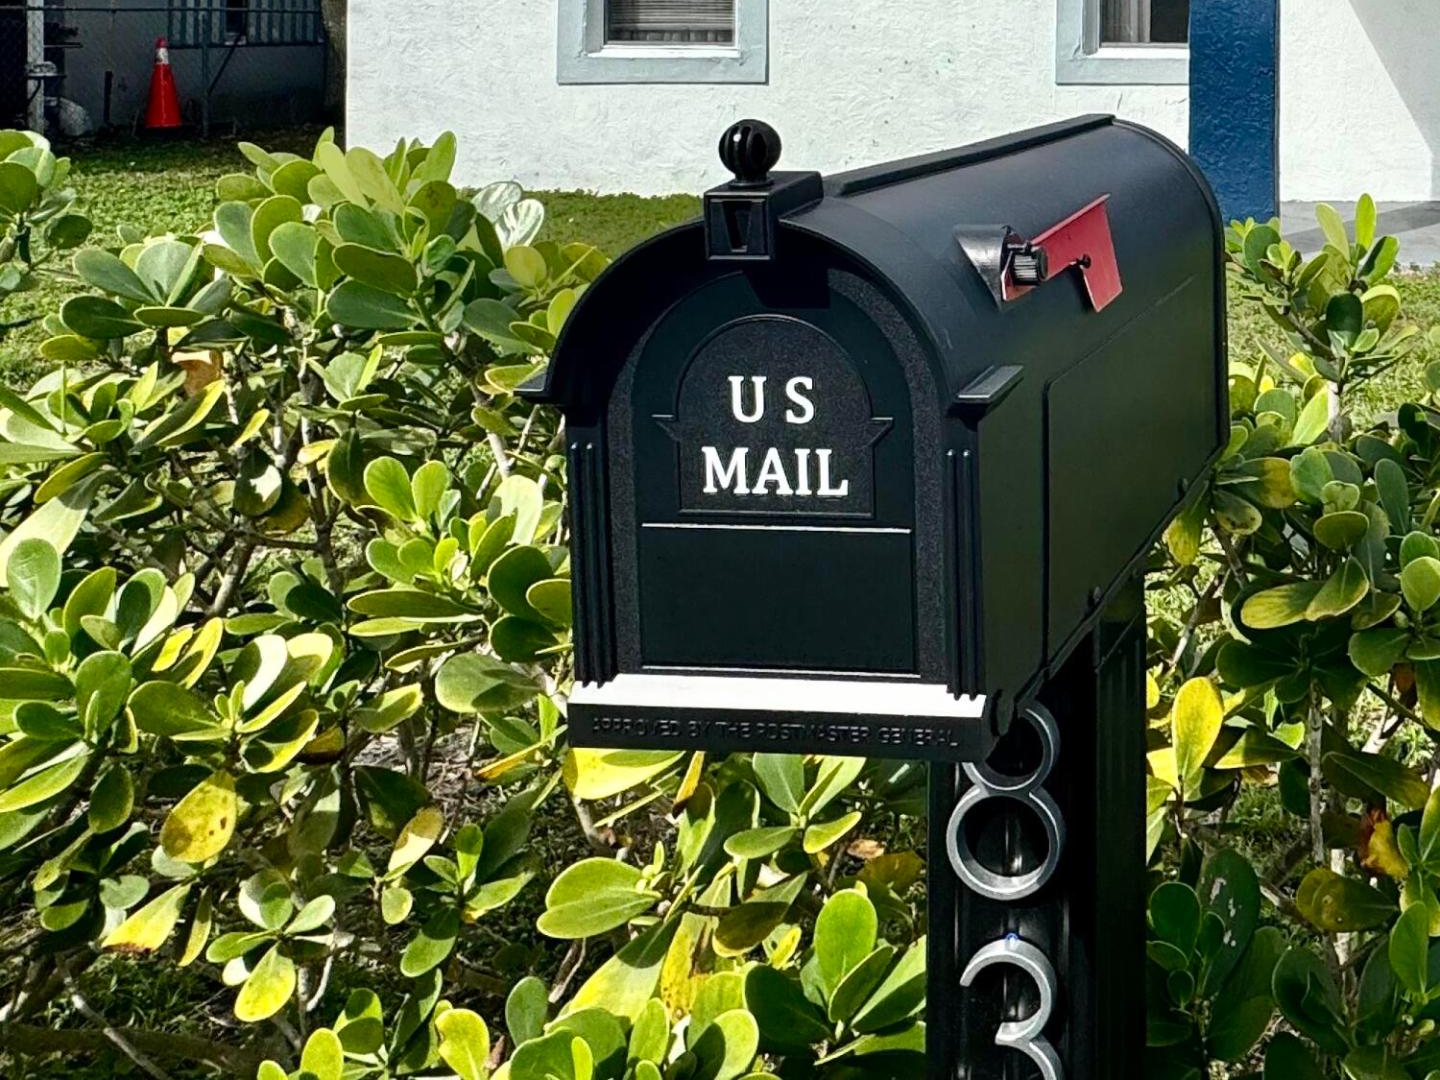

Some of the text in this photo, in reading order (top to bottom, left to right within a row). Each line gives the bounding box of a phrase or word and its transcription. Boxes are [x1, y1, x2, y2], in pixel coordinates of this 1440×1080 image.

[728, 375, 815, 424] U S
[701, 445, 849, 497] MAIL
